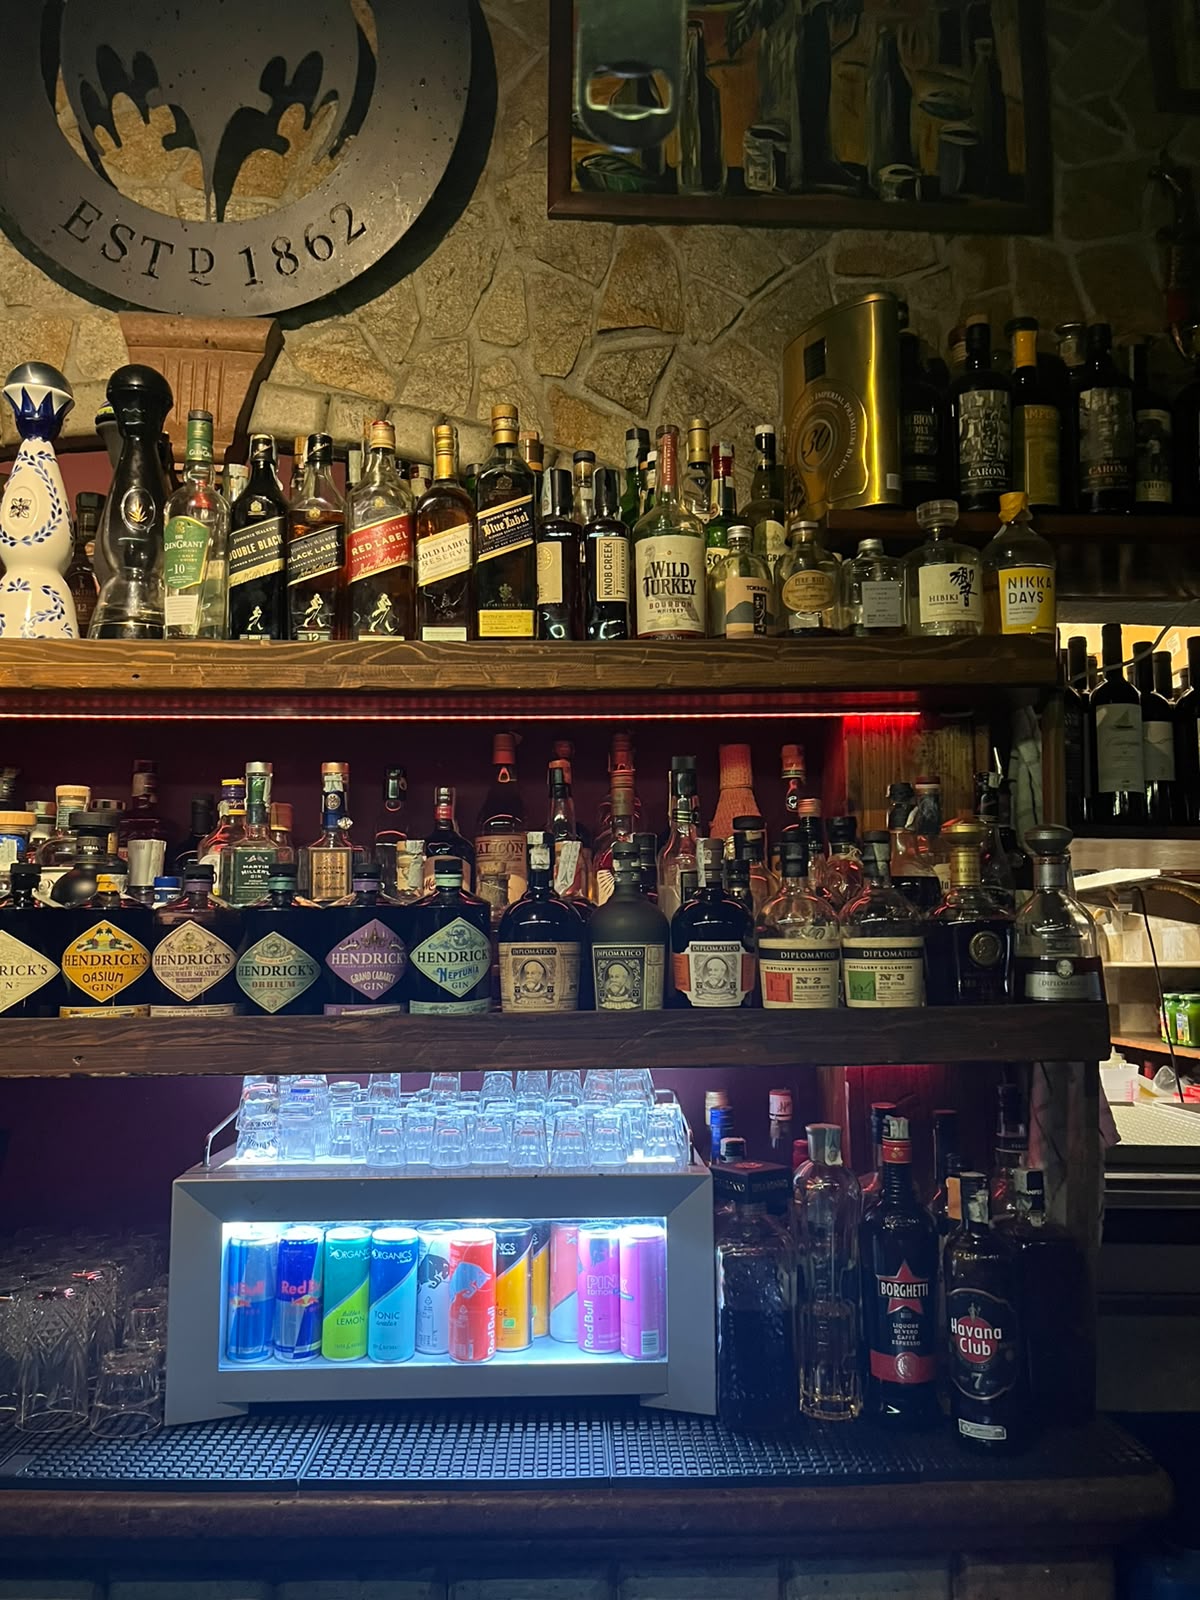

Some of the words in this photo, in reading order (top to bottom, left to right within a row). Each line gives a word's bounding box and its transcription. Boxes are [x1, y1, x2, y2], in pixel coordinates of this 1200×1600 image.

[239, 202, 367, 286] 1862
[815, 391, 845, 406] IMPERIAL
[844, 402, 857, 446] PREMIUM
[832, 449, 854, 478] BLEND
[481, 518, 506, 538] Blue
[505, 511, 530, 529] Label
[233, 533, 255, 545] JOHNNIE
[255, 526, 277, 537] WALKER
[257, 535, 284, 551] BLACK
[314, 541, 342, 555] LABEL
[352, 543, 373, 557] RED
[374, 531, 409, 547] LABEL
[441, 537, 472, 553] LABEL
[421, 548, 469, 566] RESERVE
[603, 541, 613, 571] CREEK
[174, 563, 186, 575] 10
[650, 560, 690, 579] WILD
[603, 571, 613, 596] KNOB
[642, 576, 697, 597] TURKEY
[1008, 576, 1052, 589] NIKKA
[649, 600, 691, 610] BOURBON
[928, 593, 959, 602] HIBIKI
[1008, 591, 1044, 604] DAYS
[64, 953, 148, 966] HENDRICK'S
[154, 953, 231, 966] HENDRICK'S
[0, 965, 48, 977] RICK'S
[82, 973, 124, 984] OASIUM
[238, 964, 315, 977] HENDRICK'S
[350, 971, 372, 984] GRAND
[372, 970, 396, 984] CABARET
[438, 965, 480, 983] NEPTUNIA
[897, 973, 905, 981] 3
[91, 984, 113, 992] GIN
[251, 981, 296, 989] ORBIUM
[363, 982, 384, 991] GIN
[451, 982, 469, 990] GIN
[372, 1248, 412, 1261] ORGANICS
[281, 1279, 307, 1295] Red
[880, 1281, 929, 1298] BORGHETTI
[374, 1311, 400, 1320] TONIC
[487, 1305, 496, 1331] Bull
[583, 1299, 594, 1324] Bull
[336, 1314, 366, 1326] LEMON
[584, 1324, 594, 1348] Red
[950, 1317, 1003, 1340] Havana
[487, 1331, 496, 1356] Red
[891, 1339, 921, 1347] ESPRESSO
[959, 1338, 992, 1356] Club
[970, 1372, 983, 1389] 7
